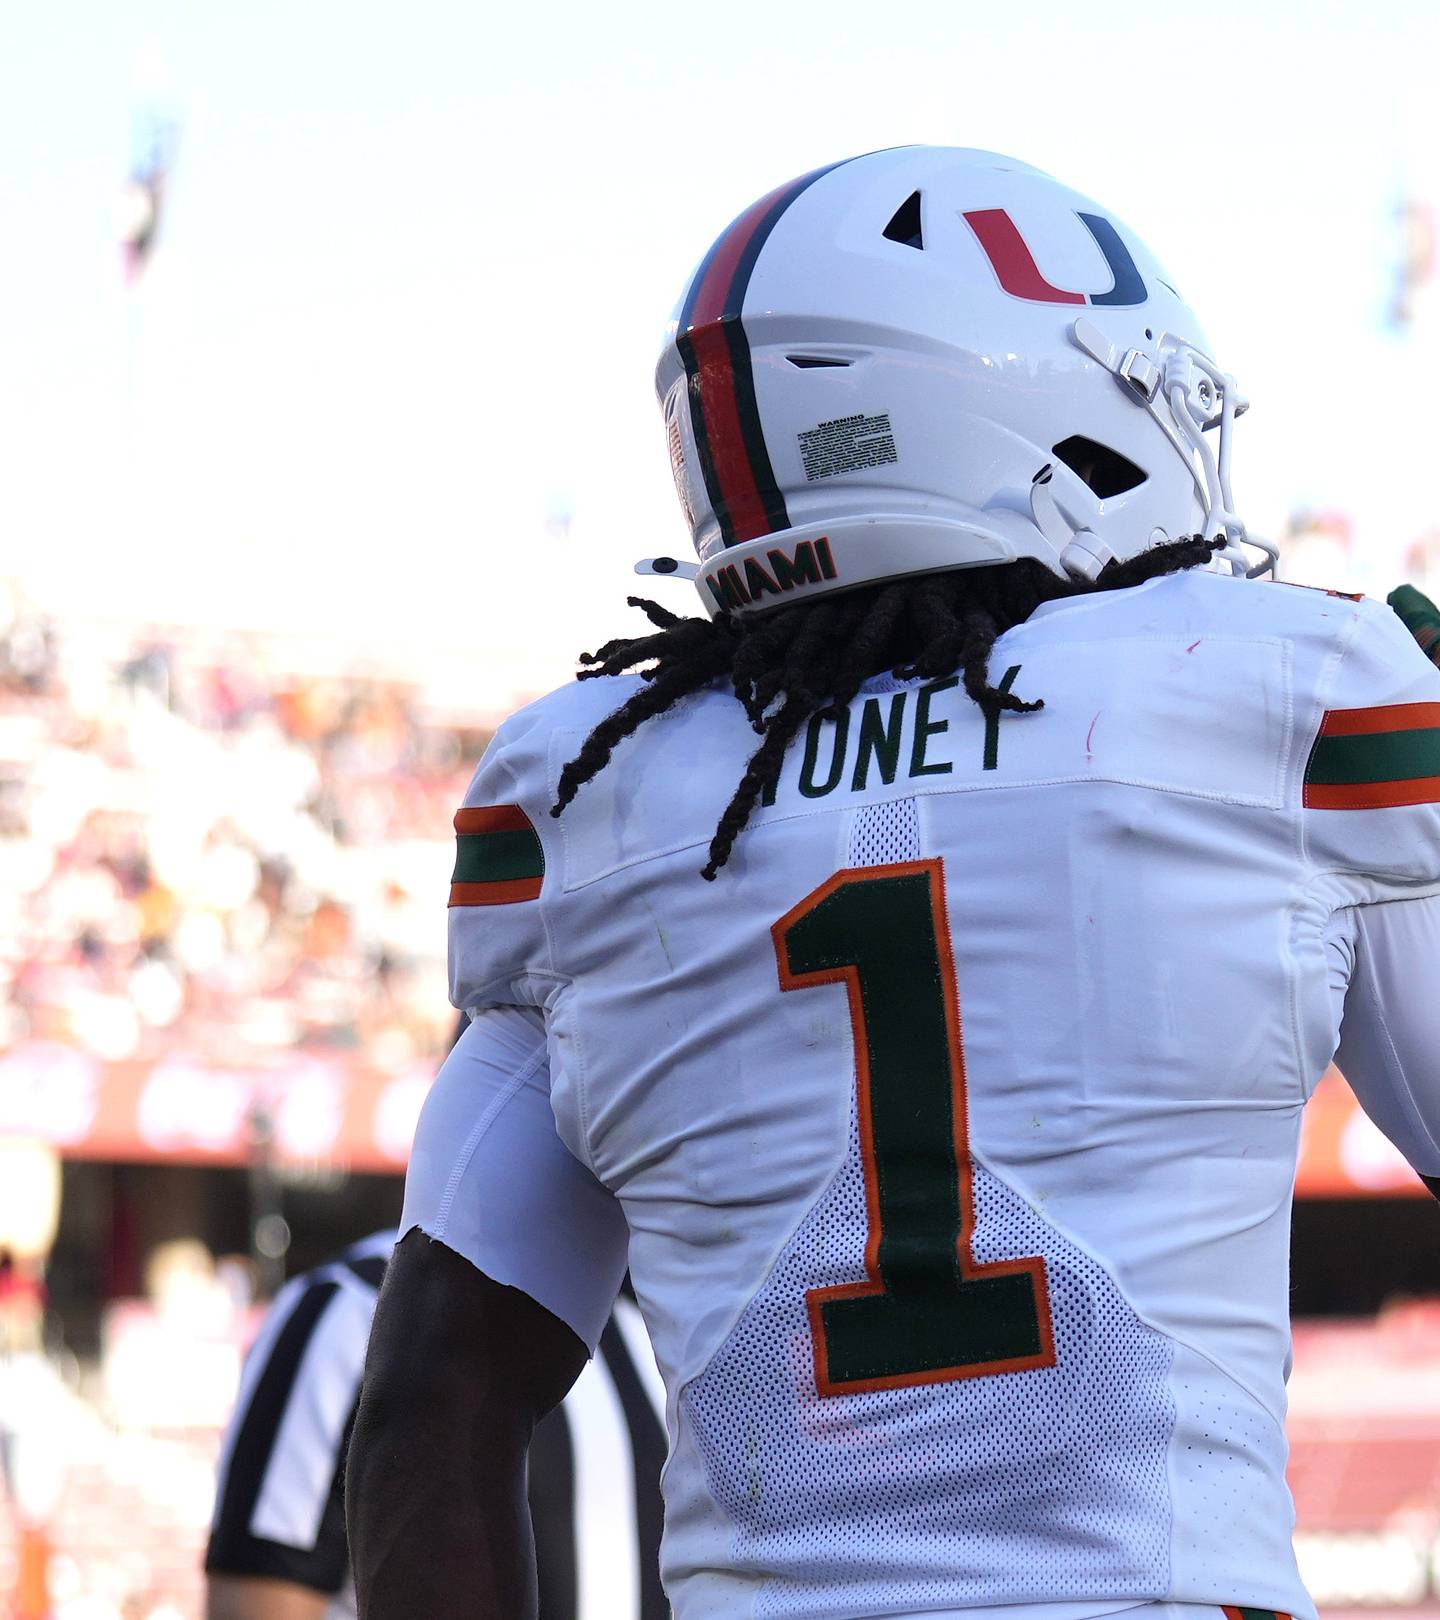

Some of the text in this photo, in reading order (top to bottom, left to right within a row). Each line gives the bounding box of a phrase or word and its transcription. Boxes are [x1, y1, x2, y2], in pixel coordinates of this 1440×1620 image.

[961, 207, 1149, 307] U
[817, 414, 866, 429] WARNING
[705, 536, 839, 611] MIAMI
[770, 856, 1057, 1398] 1
